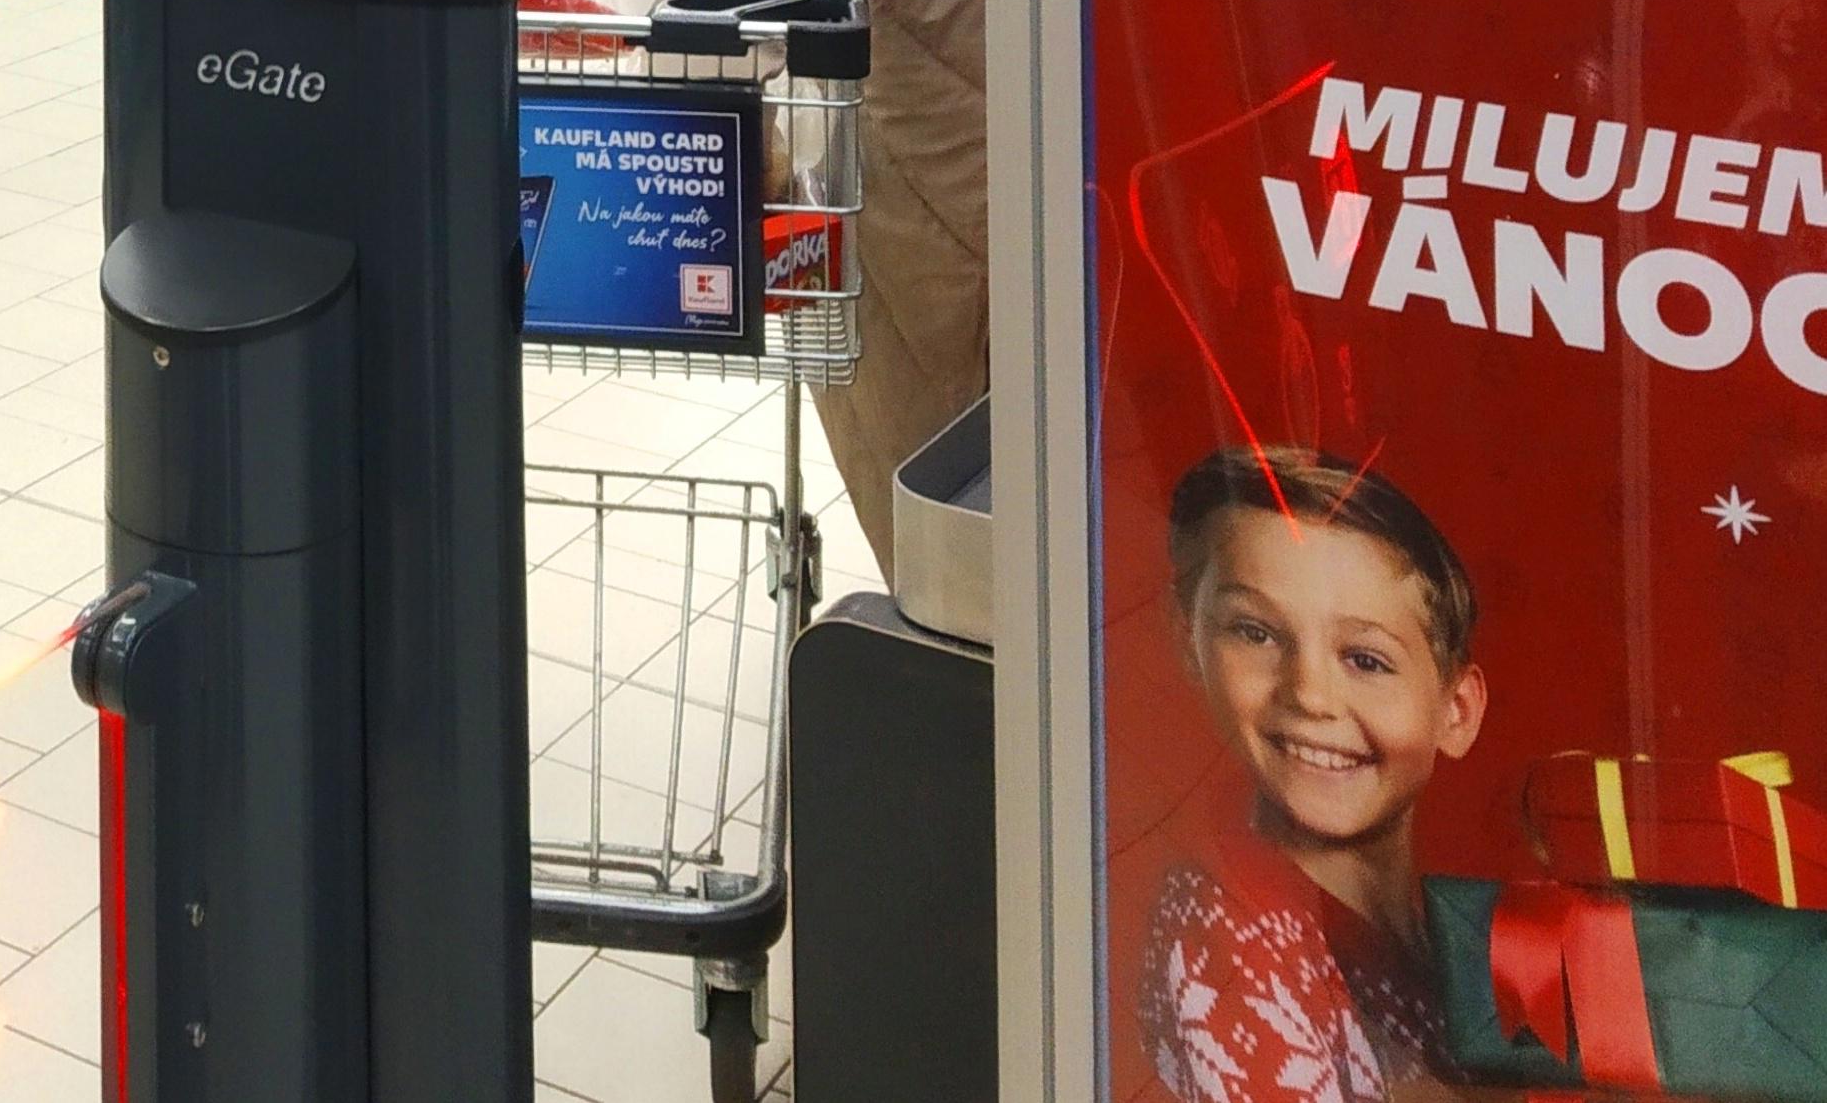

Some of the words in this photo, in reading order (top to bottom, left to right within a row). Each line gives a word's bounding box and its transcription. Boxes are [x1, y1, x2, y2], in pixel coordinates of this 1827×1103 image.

[196, 48, 326, 103] eGate
[534, 126, 656, 150] KAUFLAND
[661, 132, 724, 152] CARD
[575, 149, 613, 171] MÁ
[618, 154, 724, 174] SPOUSTU
[636, 174, 726, 197] VÝHOD!
[577, 196, 611, 223] Na
[612, 201, 665, 229] jakou
[670, 205, 712, 228] máte
[627, 227, 670, 250] chuť
[672, 227, 727, 253] dnes?
